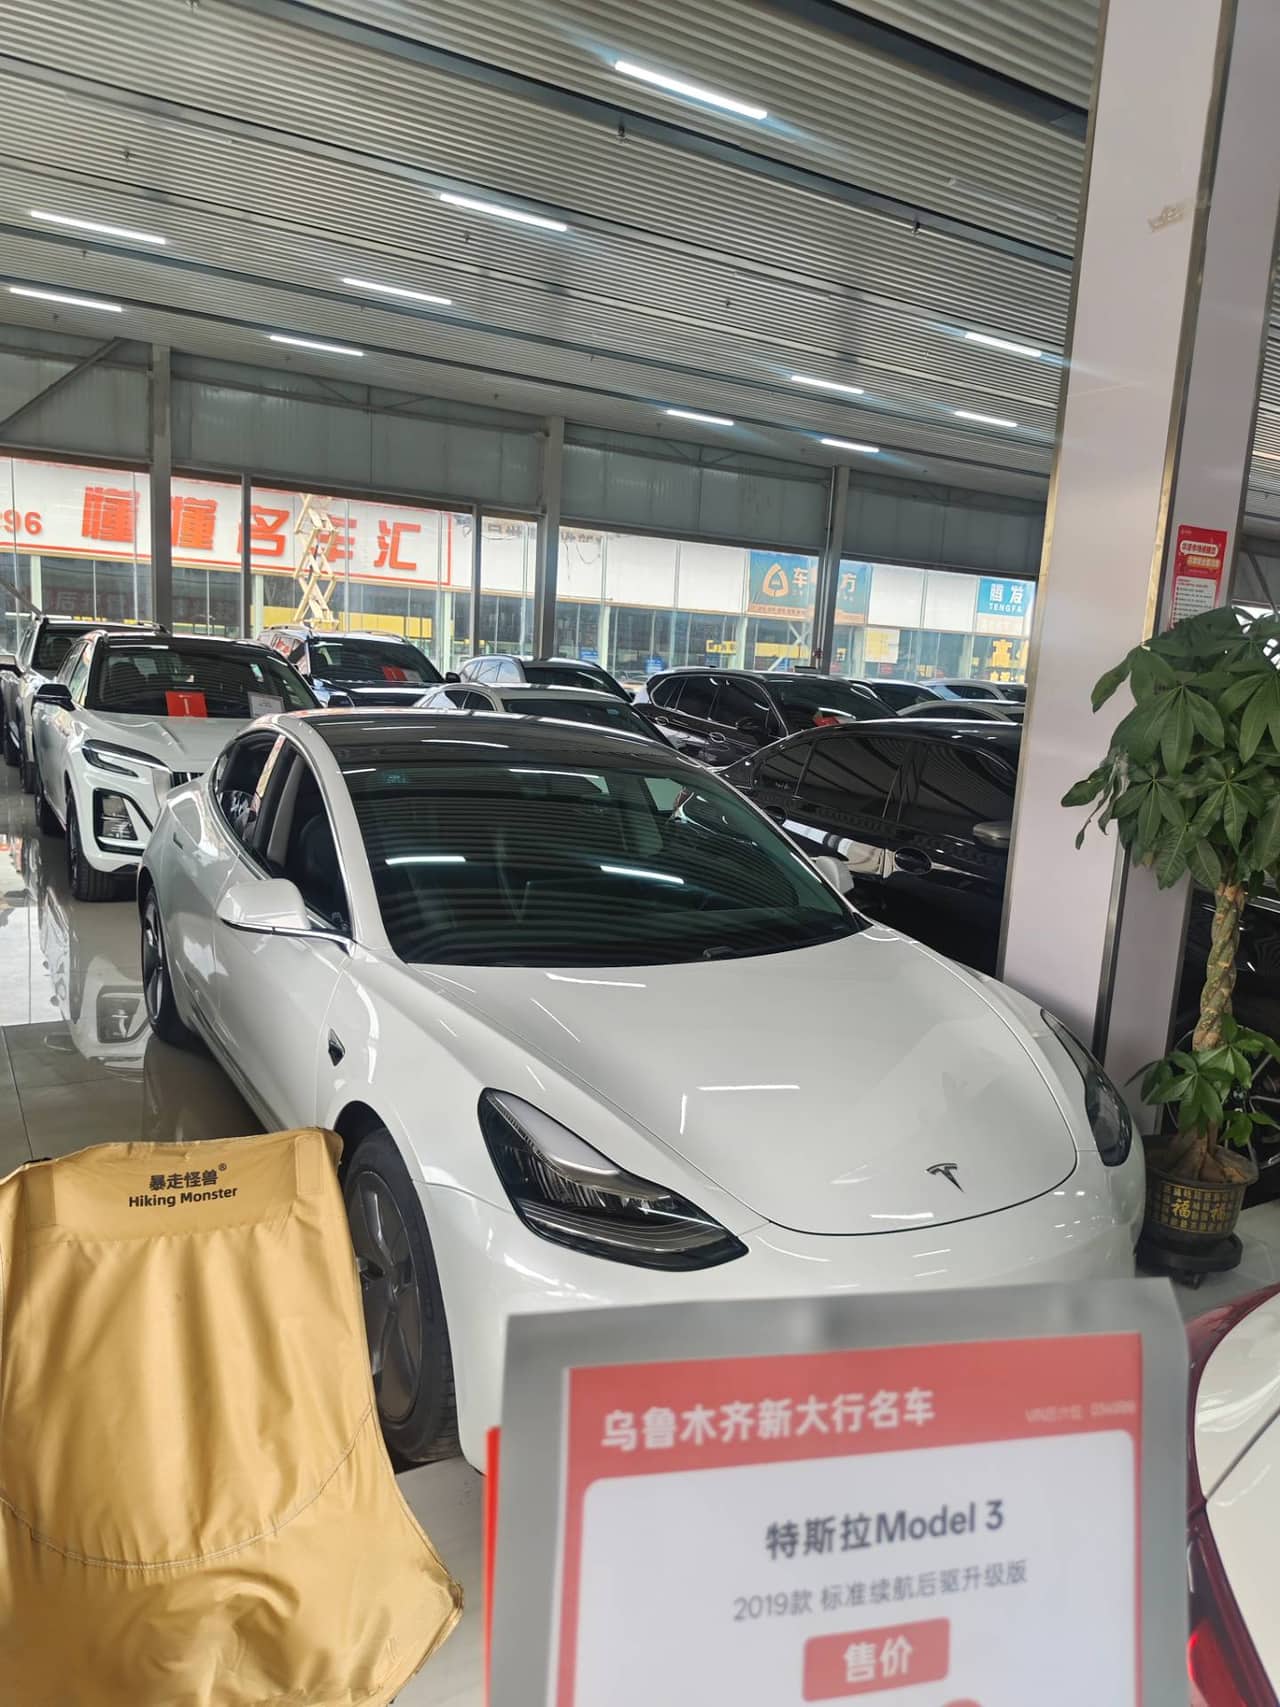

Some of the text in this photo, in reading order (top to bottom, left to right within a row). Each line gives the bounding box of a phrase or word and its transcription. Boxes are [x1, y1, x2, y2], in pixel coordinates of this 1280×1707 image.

[128, 1187, 238, 1208] Hiking Monster
[149, 1169, 218, 1191] 暴走怪兽
[602, 1388, 935, 1452] 乌鲁木齐新大行名车
[985, 1499, 1005, 1531] 3
[732, 1558, 1029, 1622] 2019款 标准续航后驱升级版
[843, 1634, 913, 1683] 售价
